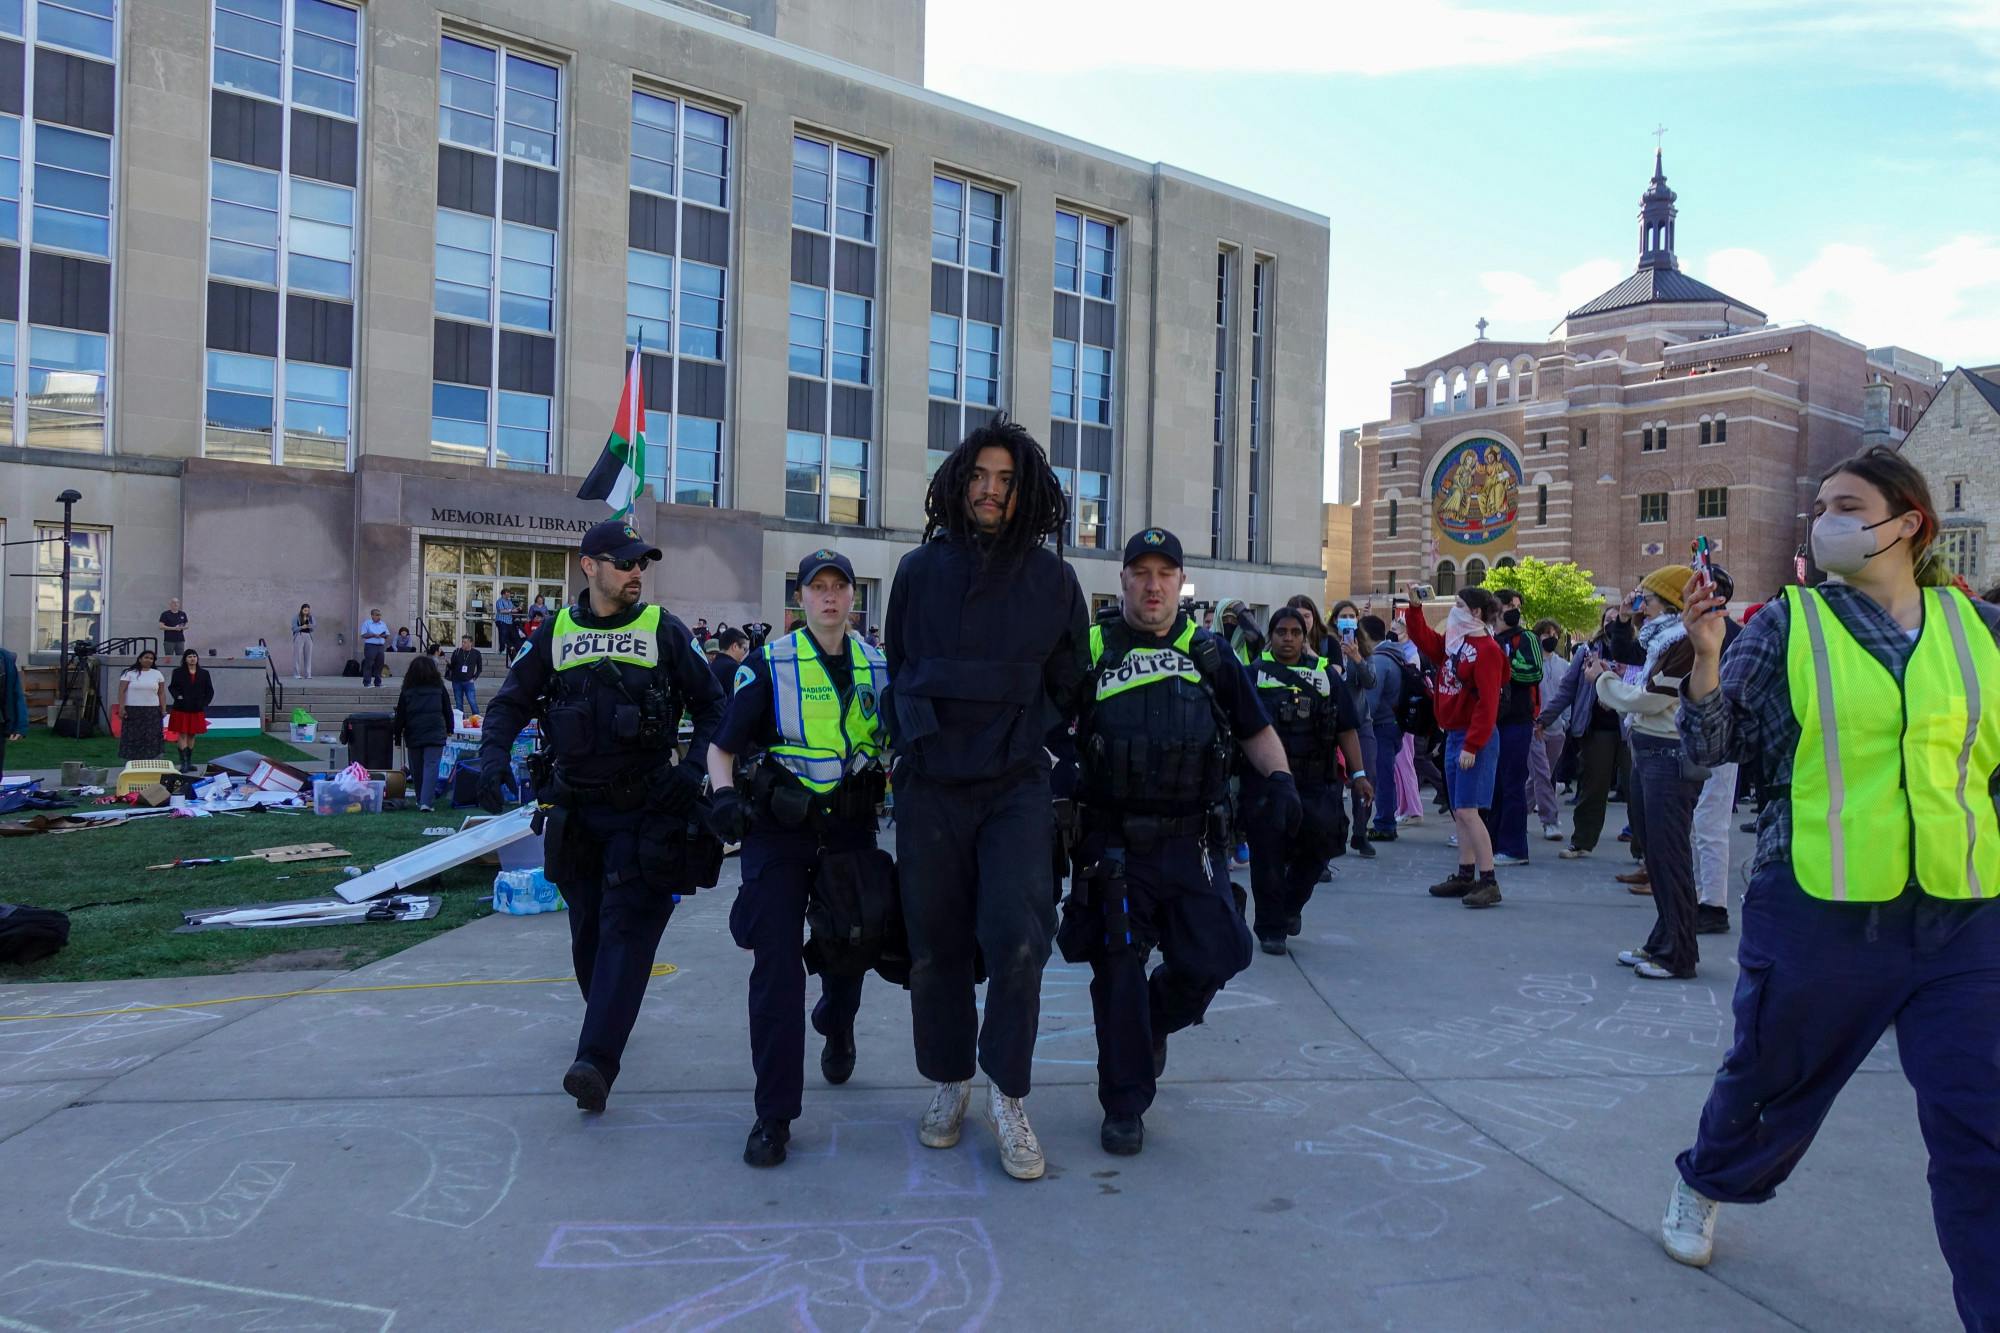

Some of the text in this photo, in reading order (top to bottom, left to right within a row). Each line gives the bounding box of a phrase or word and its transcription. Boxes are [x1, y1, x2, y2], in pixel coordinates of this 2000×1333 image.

[431, 508, 525, 528] MEMORIAL
[577, 633, 632, 642] MADISON
[562, 639, 647, 660] POLICE
[1102, 657, 1194, 688] POLICE
[801, 686, 833, 694] MADISON
